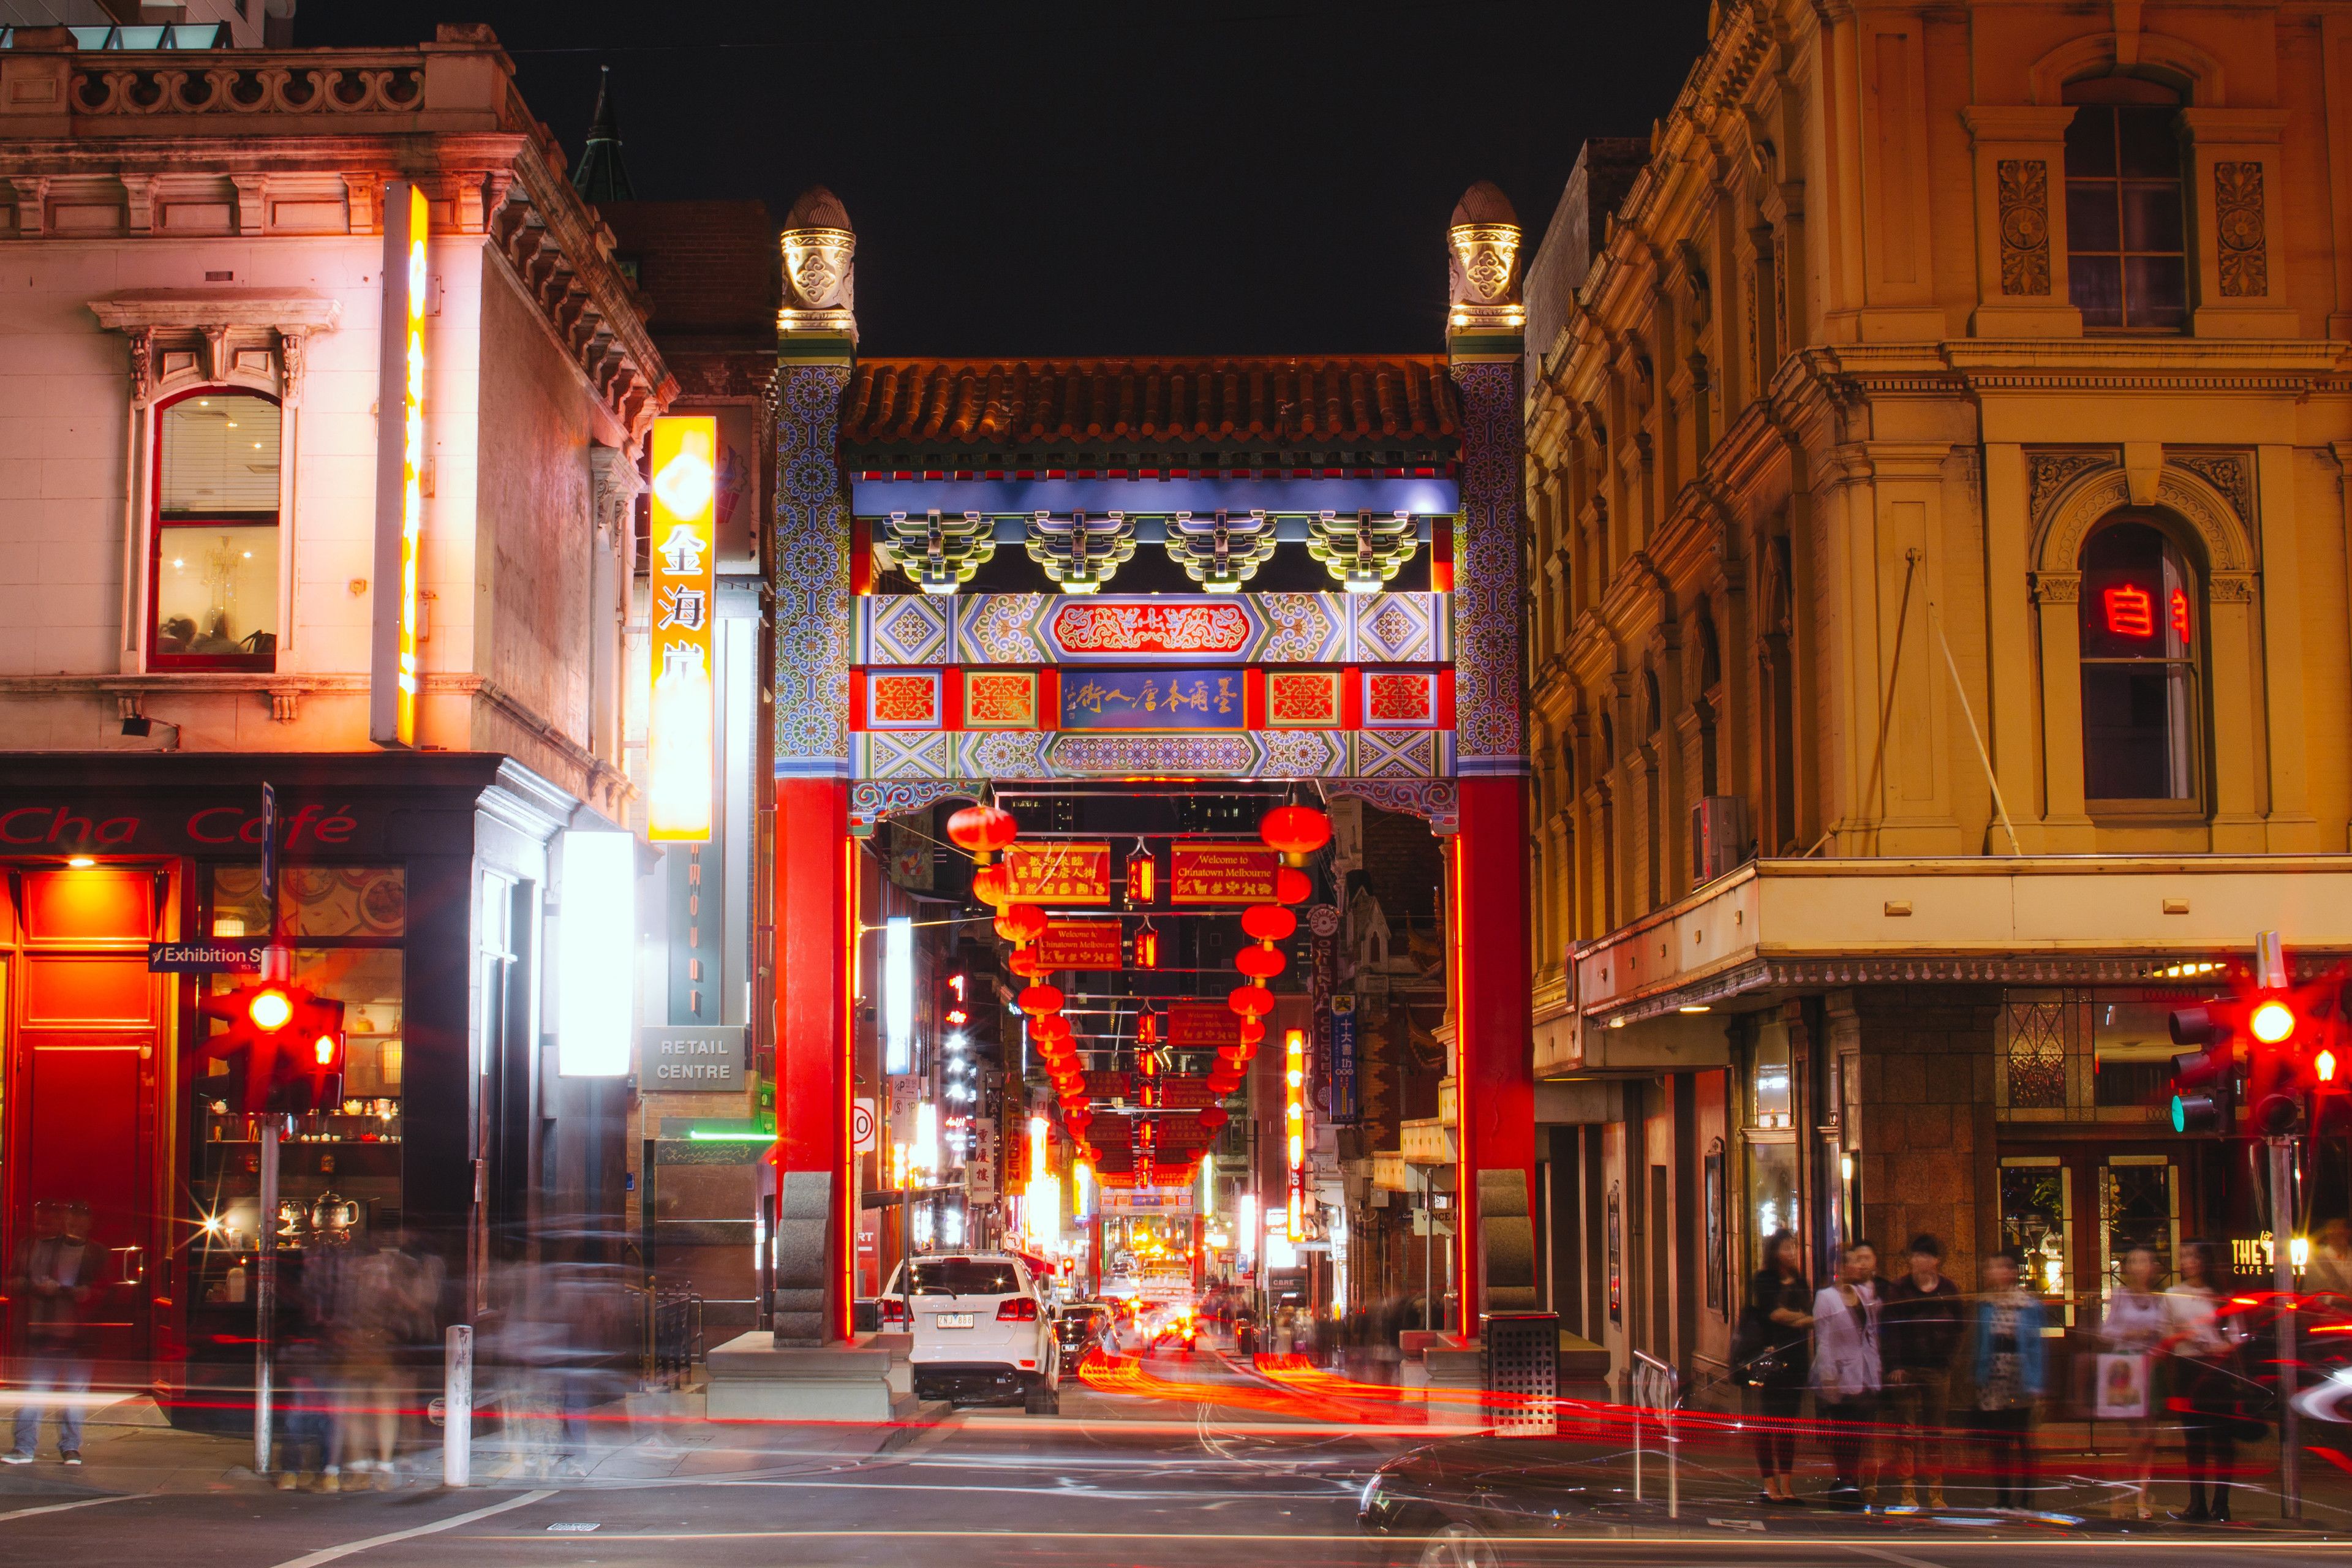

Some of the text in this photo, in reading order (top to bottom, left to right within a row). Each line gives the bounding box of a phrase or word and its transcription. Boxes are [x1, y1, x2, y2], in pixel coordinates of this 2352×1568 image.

[0, 804, 357, 850] Cha Café
[1199, 855, 1237, 864] Welcome
[1178, 868, 1272, 877] Chinatown Melbourne
[165, 948, 262, 962] Exhibition S
[661, 1039, 728, 1055] RETAIL
[657, 1064, 731, 1080] CENTRE
[856, 1116, 869, 1134] 0
[1422, 1212, 1450, 1221] VNCE
[2231, 1239, 2262, 1265] THE
[2233, 1265, 2307, 1276] CAFE AR
[938, 1316, 972, 1324] ZNJ 888
